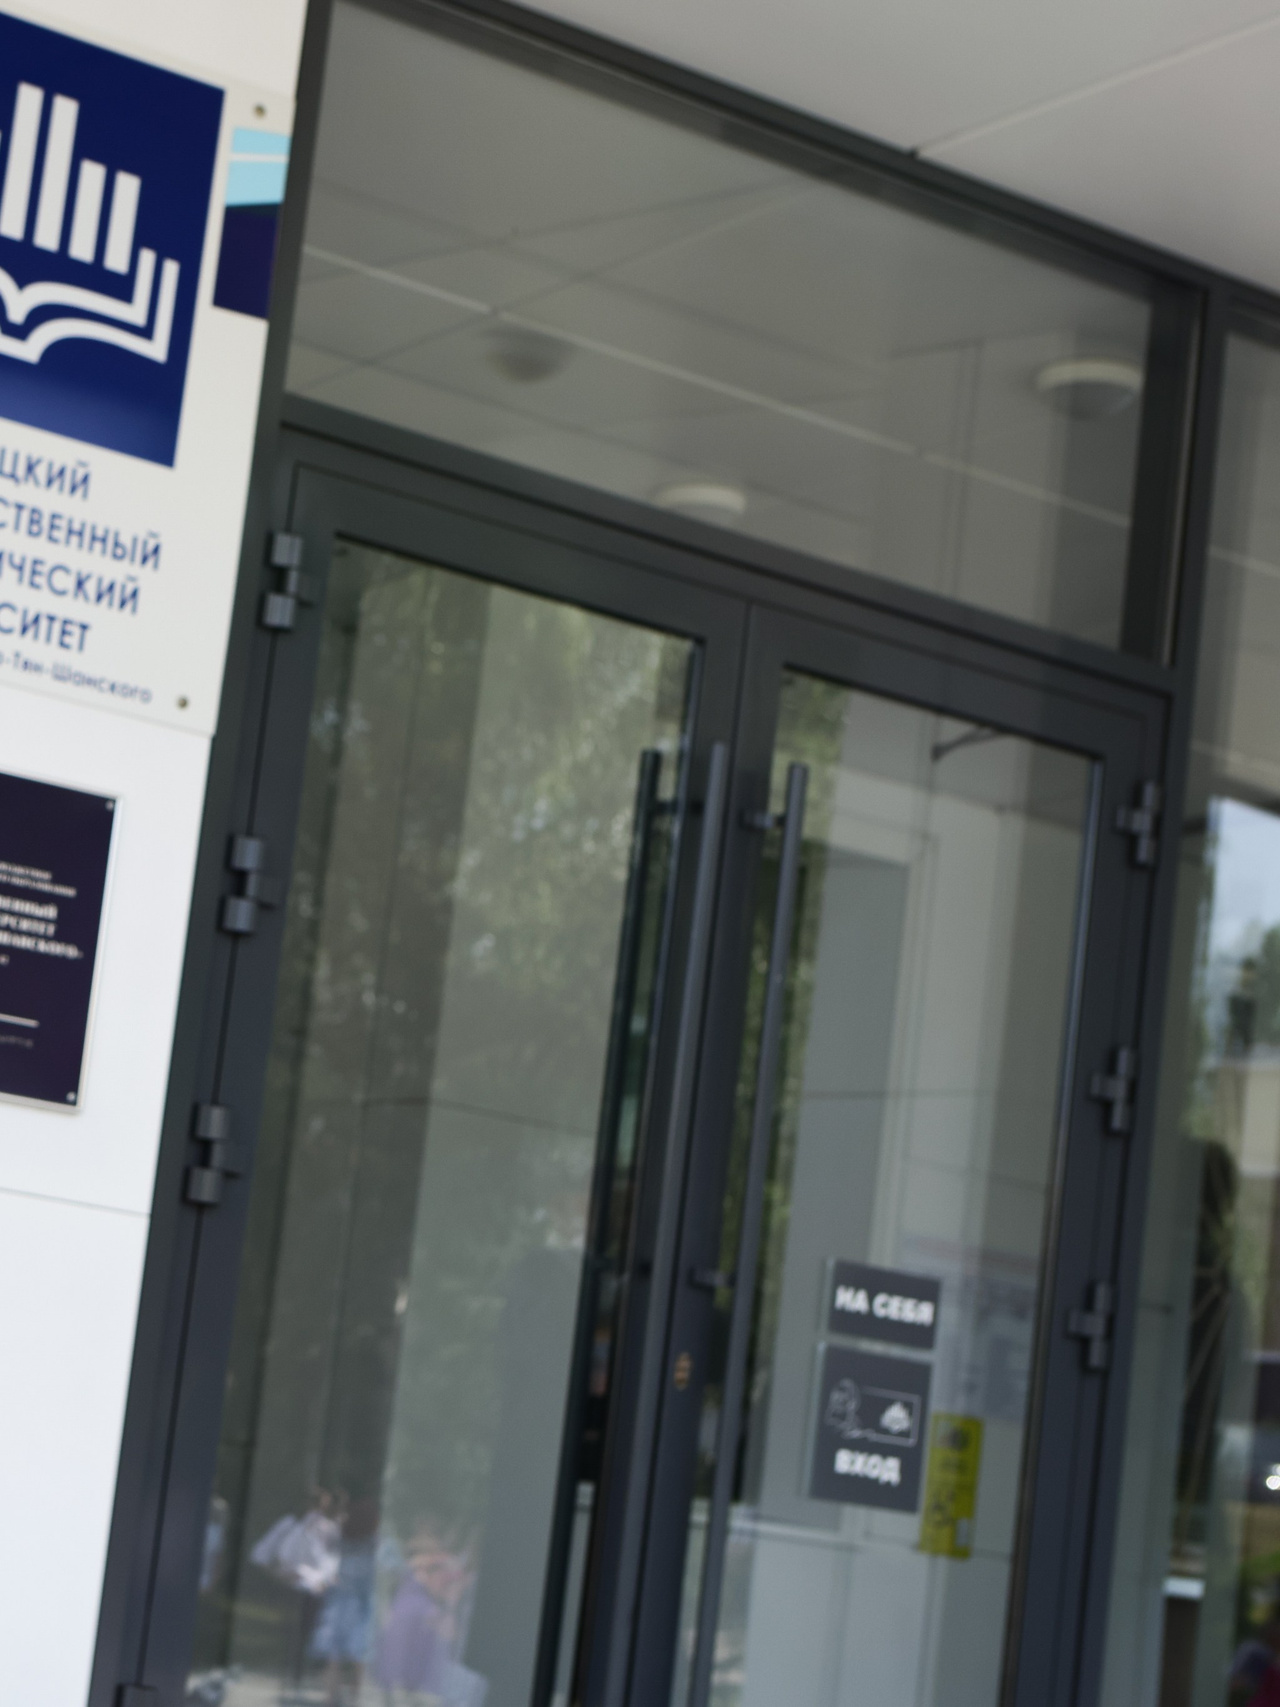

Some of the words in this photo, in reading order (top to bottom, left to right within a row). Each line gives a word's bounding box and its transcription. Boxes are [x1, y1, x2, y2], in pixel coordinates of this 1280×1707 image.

[834, 1285, 869, 1314] НА
[872, 1292, 935, 1327] СЕБЯ
[834, 1448, 901, 1487] ВХОД
